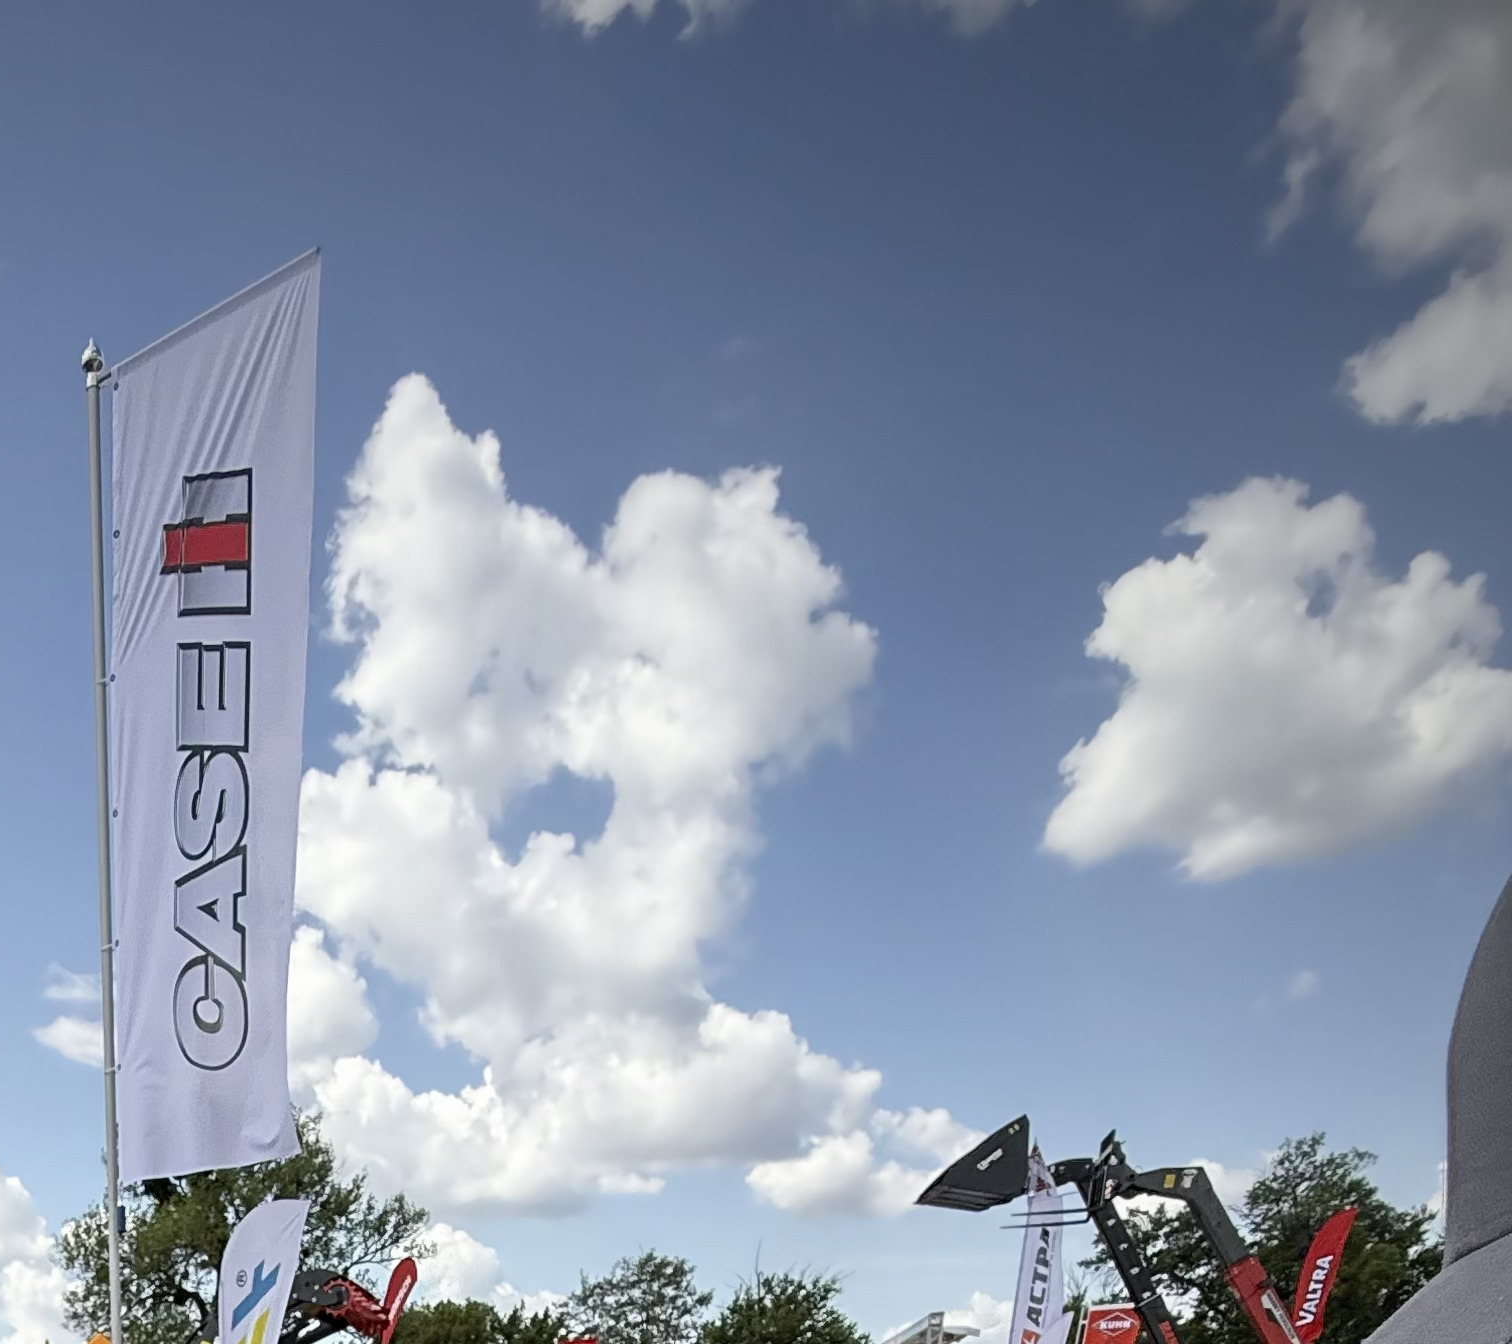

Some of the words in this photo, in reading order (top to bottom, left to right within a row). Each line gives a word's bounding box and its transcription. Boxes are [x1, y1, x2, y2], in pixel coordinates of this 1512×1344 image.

[173, 641, 252, 1070] CASE
[1099, 1320, 1131, 1330] KUHN
[1295, 1255, 1334, 1327] VALTRA
